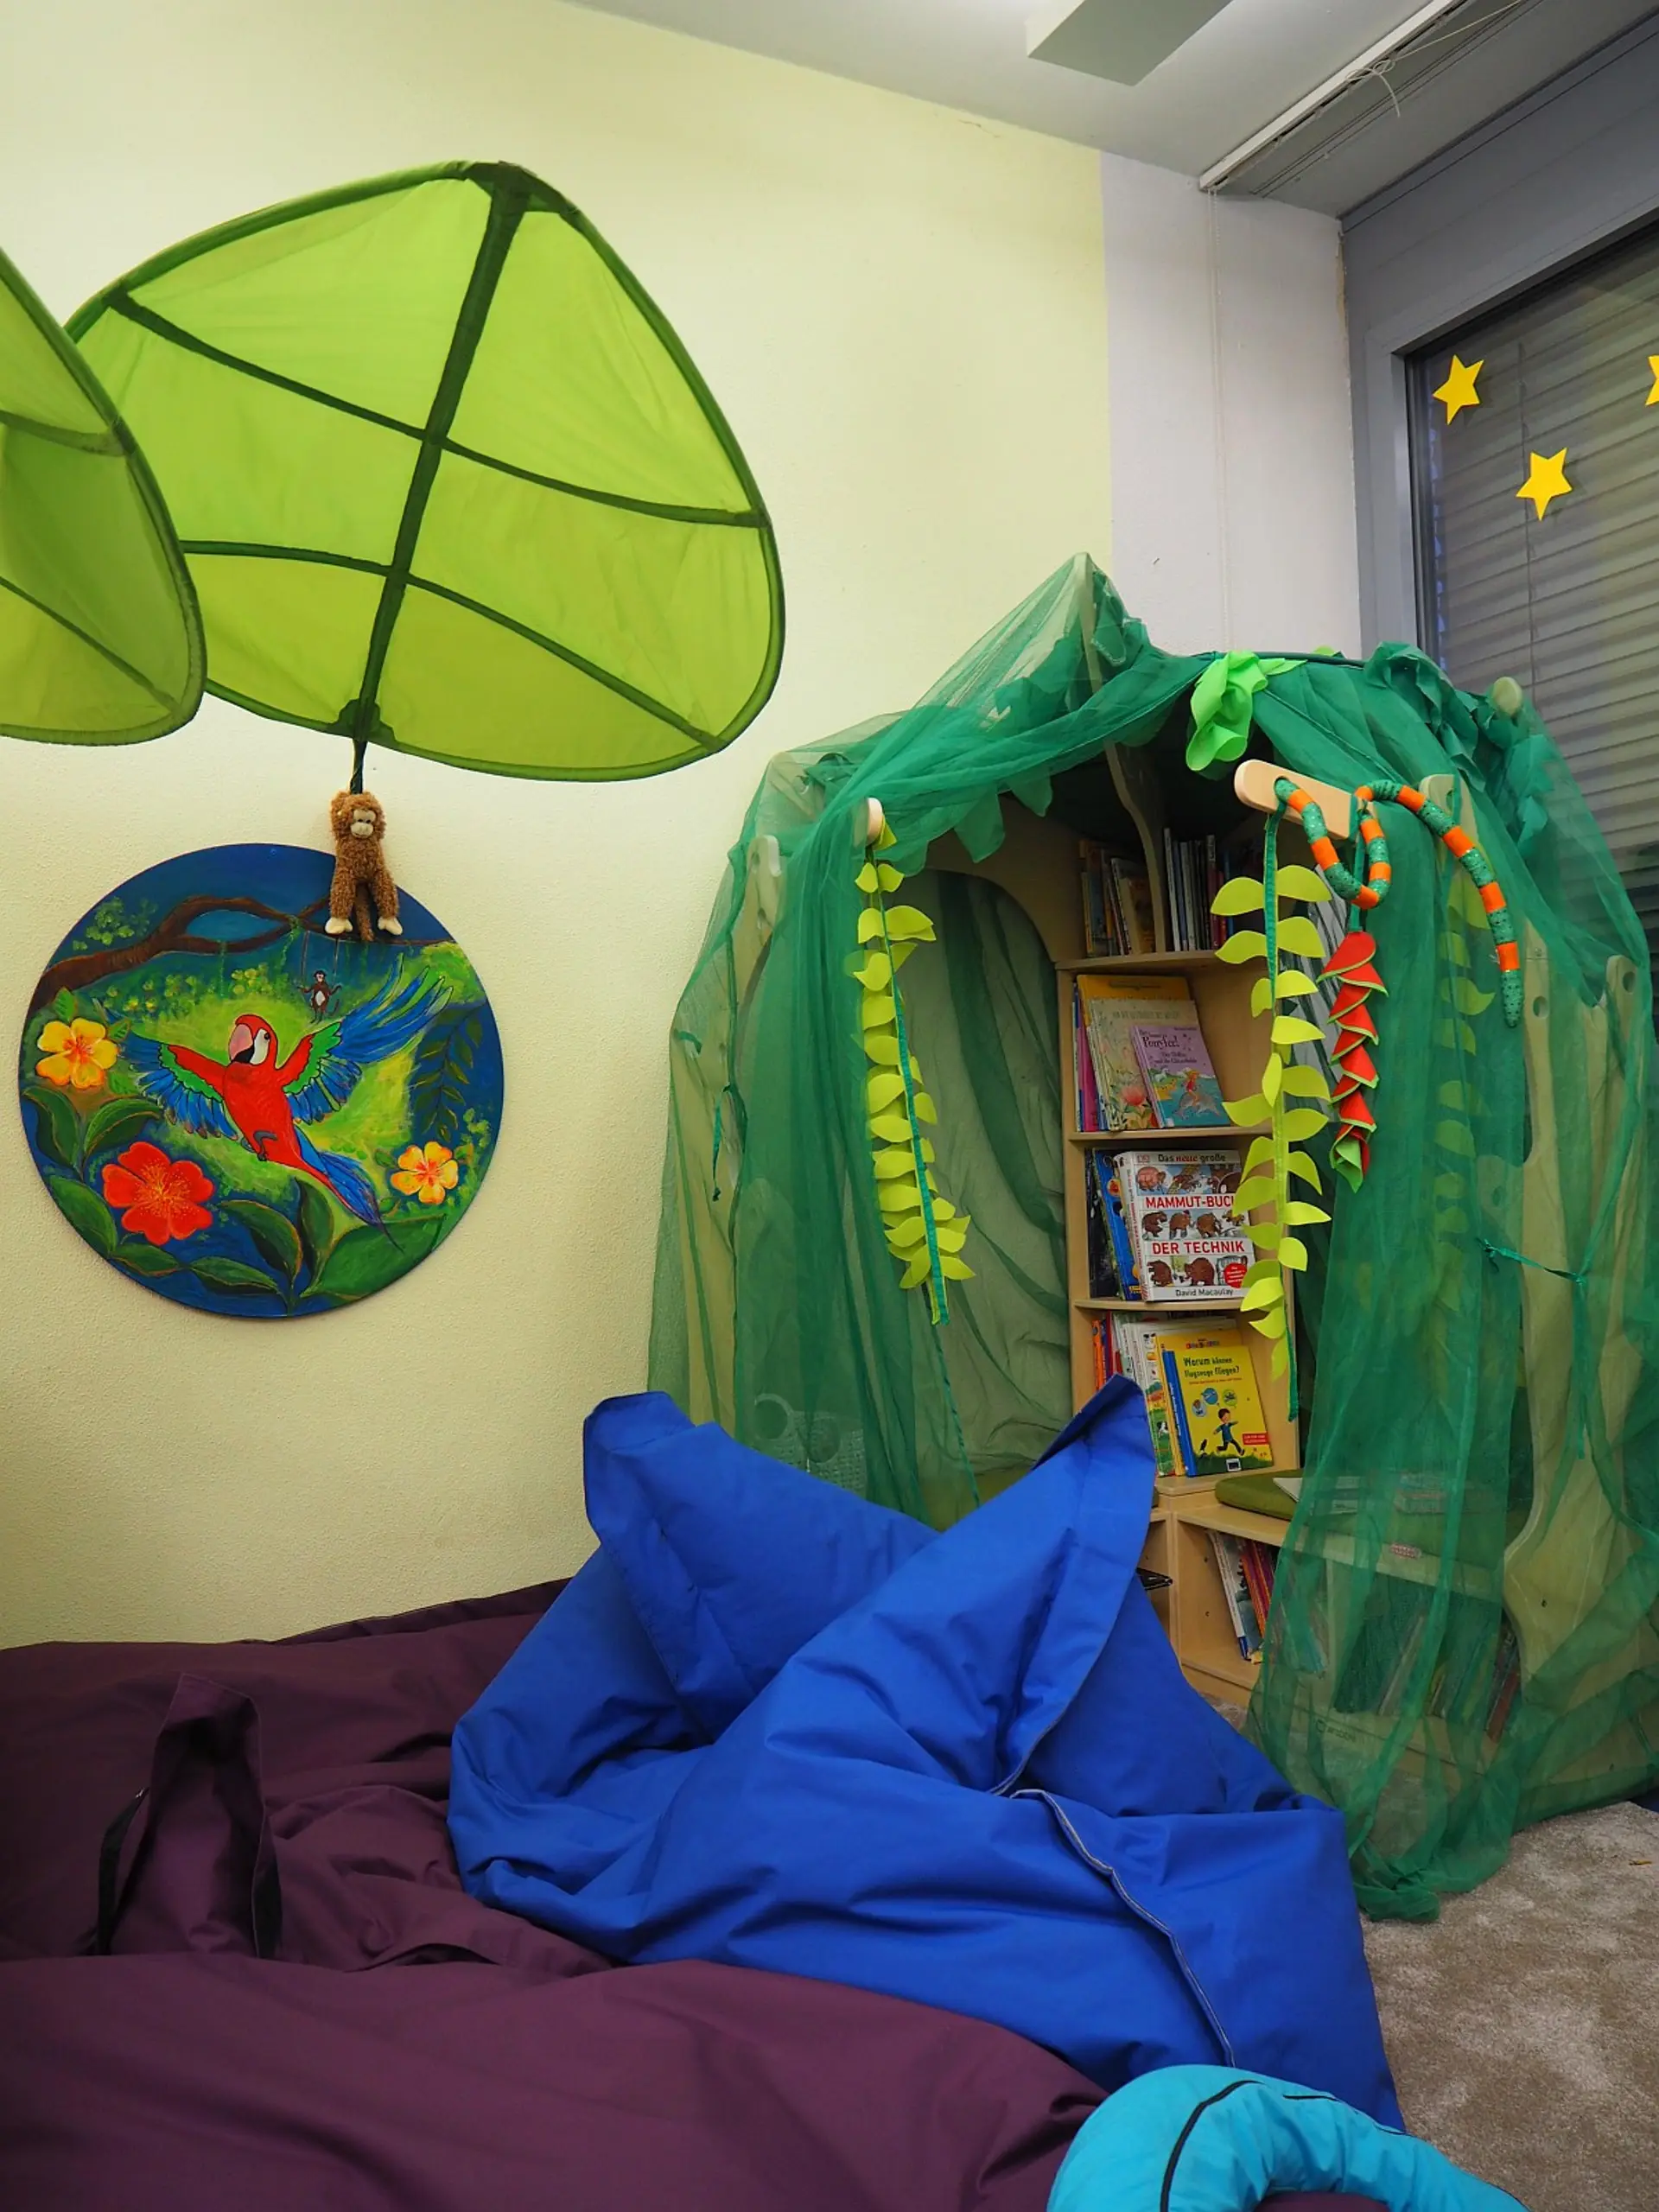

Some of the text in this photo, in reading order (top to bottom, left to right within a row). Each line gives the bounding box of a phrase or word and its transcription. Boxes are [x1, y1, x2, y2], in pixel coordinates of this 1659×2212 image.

[1158, 1154, 1175, 1162] Das
[1199, 1154, 1226, 1163] große
[1152, 1240, 1245, 1255] DER TECHNIK
[1198, 1288, 1234, 1297] Macaulay
